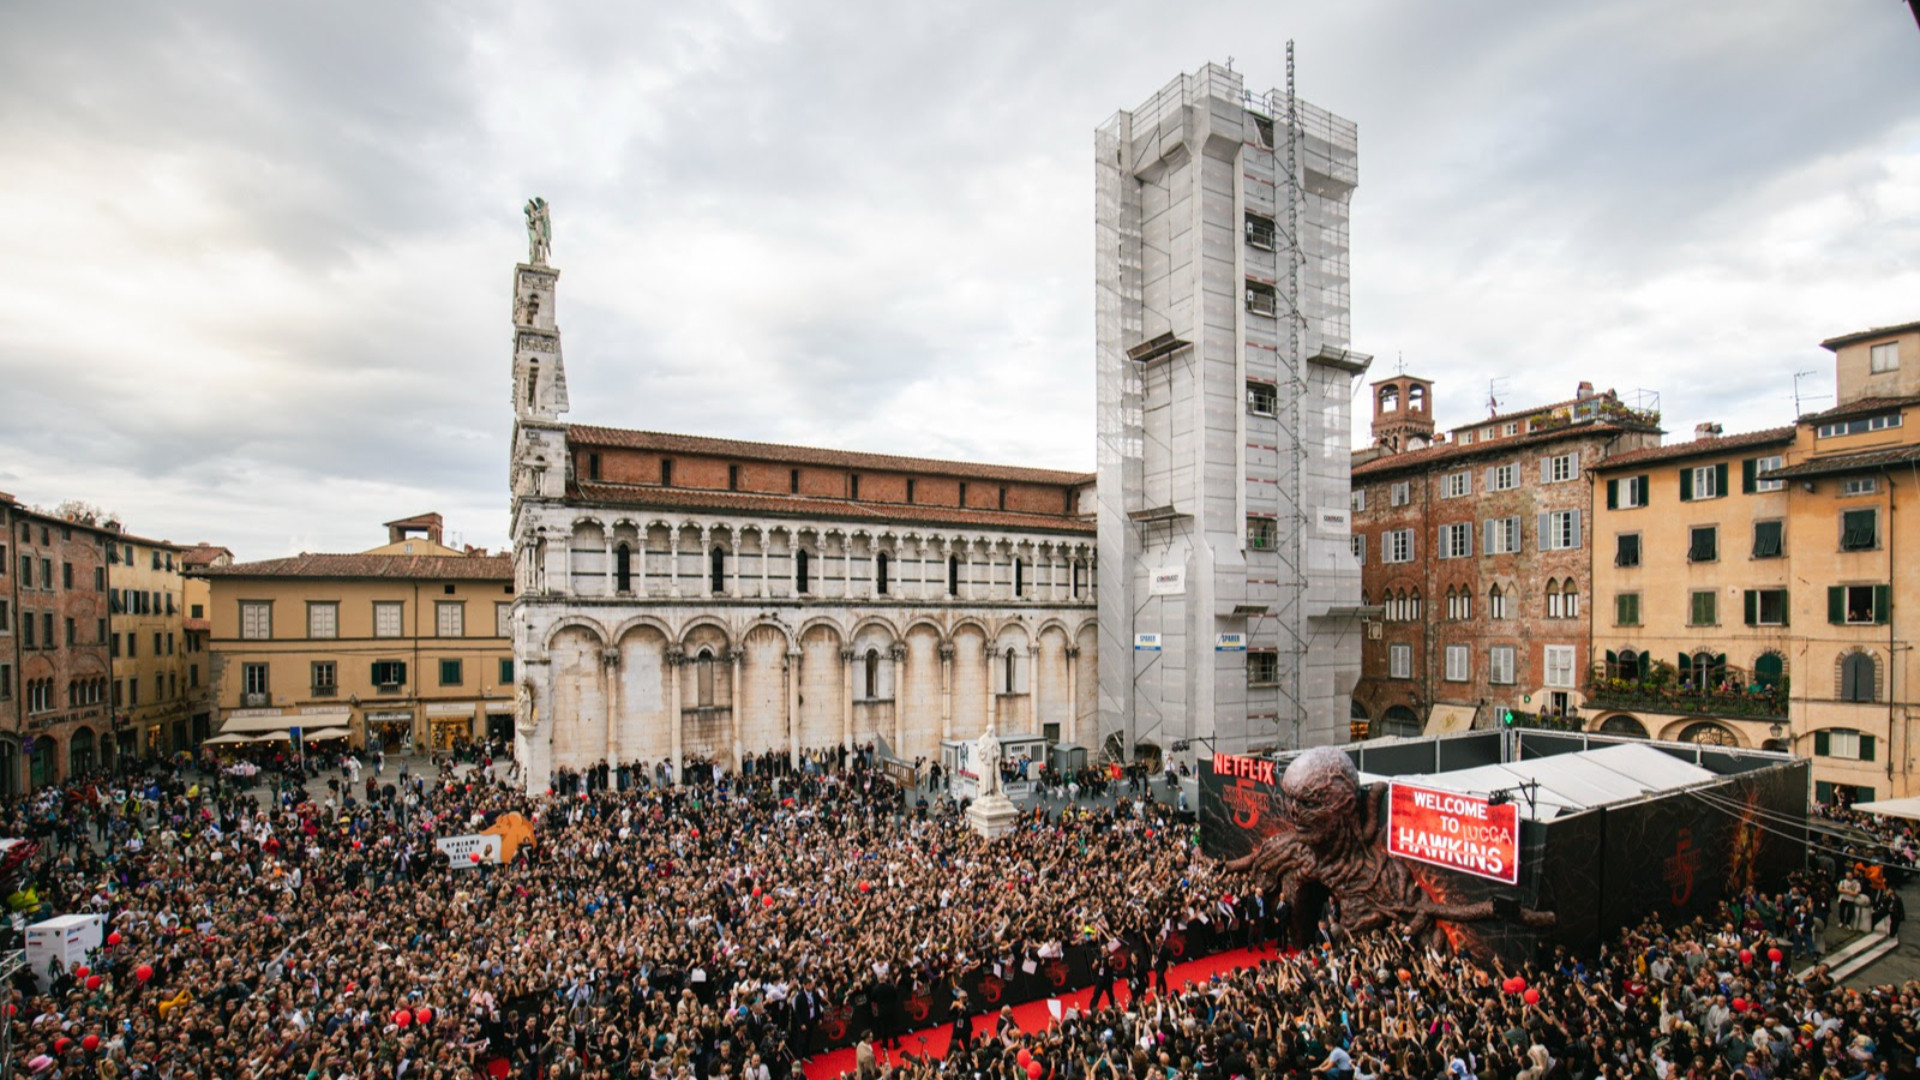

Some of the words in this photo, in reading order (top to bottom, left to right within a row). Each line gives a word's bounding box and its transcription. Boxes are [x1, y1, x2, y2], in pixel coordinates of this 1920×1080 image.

[1213, 752, 1276, 786] NETFLIX
[1414, 791, 1488, 820] WELCOME
[1440, 815, 1459, 834] TO
[1462, 825, 1513, 845] LUCCA
[1399, 827, 1503, 873] HAWKINS
